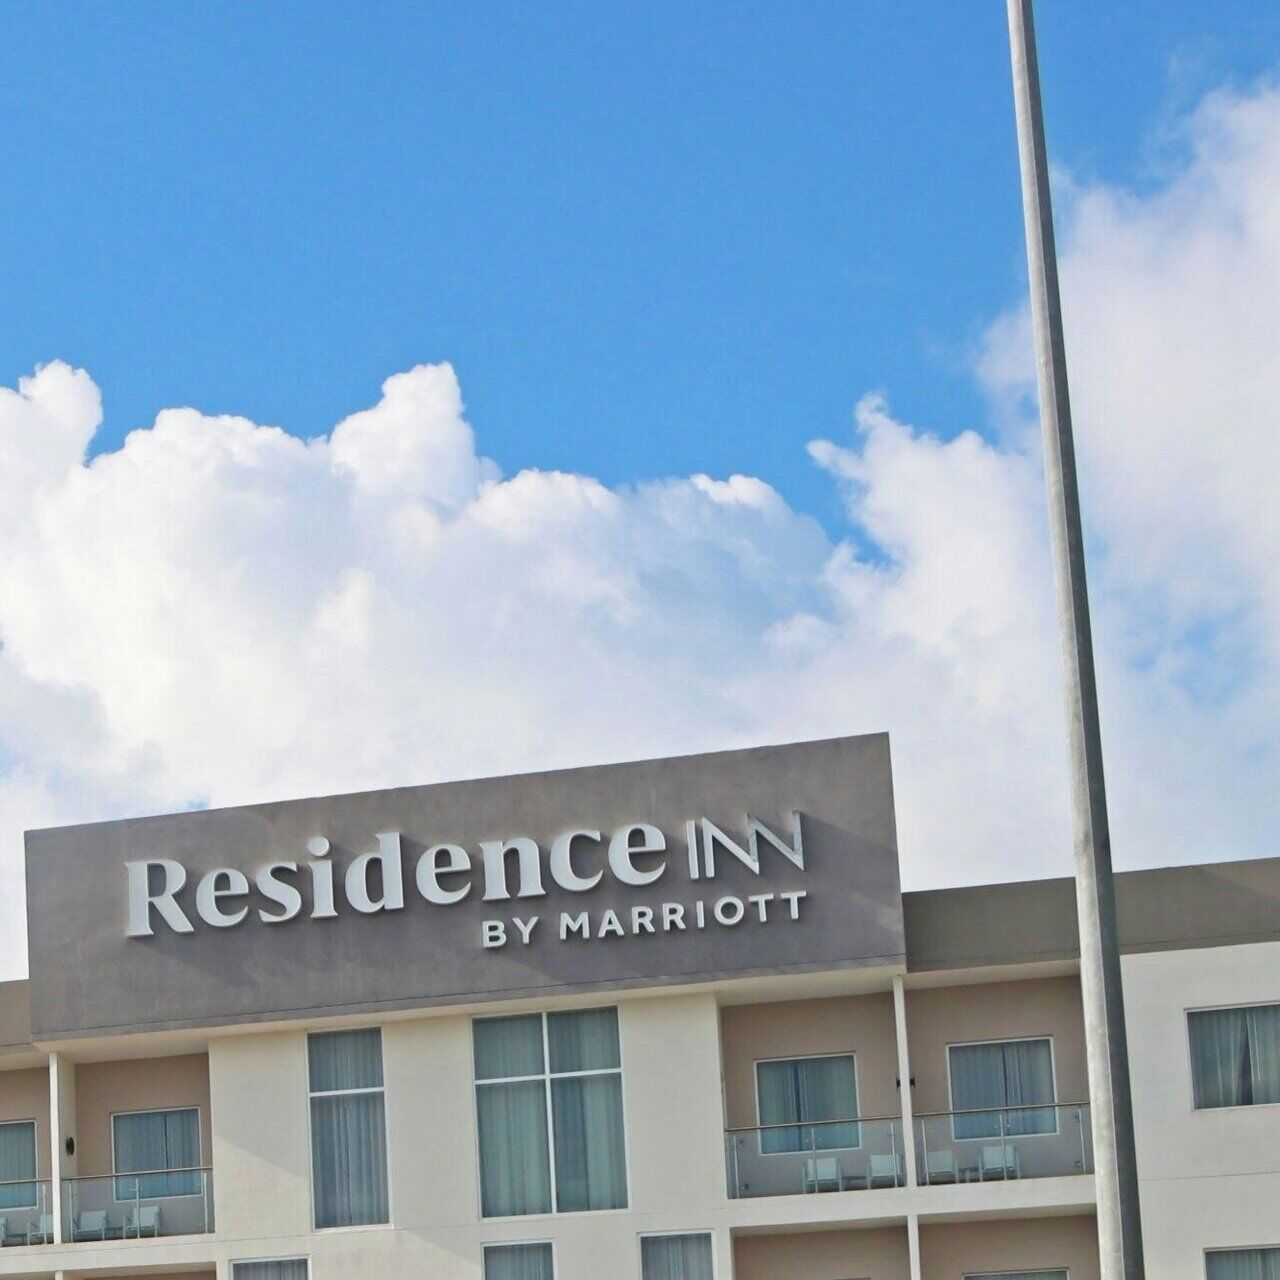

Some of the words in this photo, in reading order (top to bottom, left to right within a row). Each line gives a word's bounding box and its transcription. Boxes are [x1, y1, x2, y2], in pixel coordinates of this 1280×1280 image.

[125, 820, 666, 937] Residence
[686, 810, 806, 880] INN
[481, 916, 538, 948] BY
[559, 890, 807, 940] MARRIOTT
